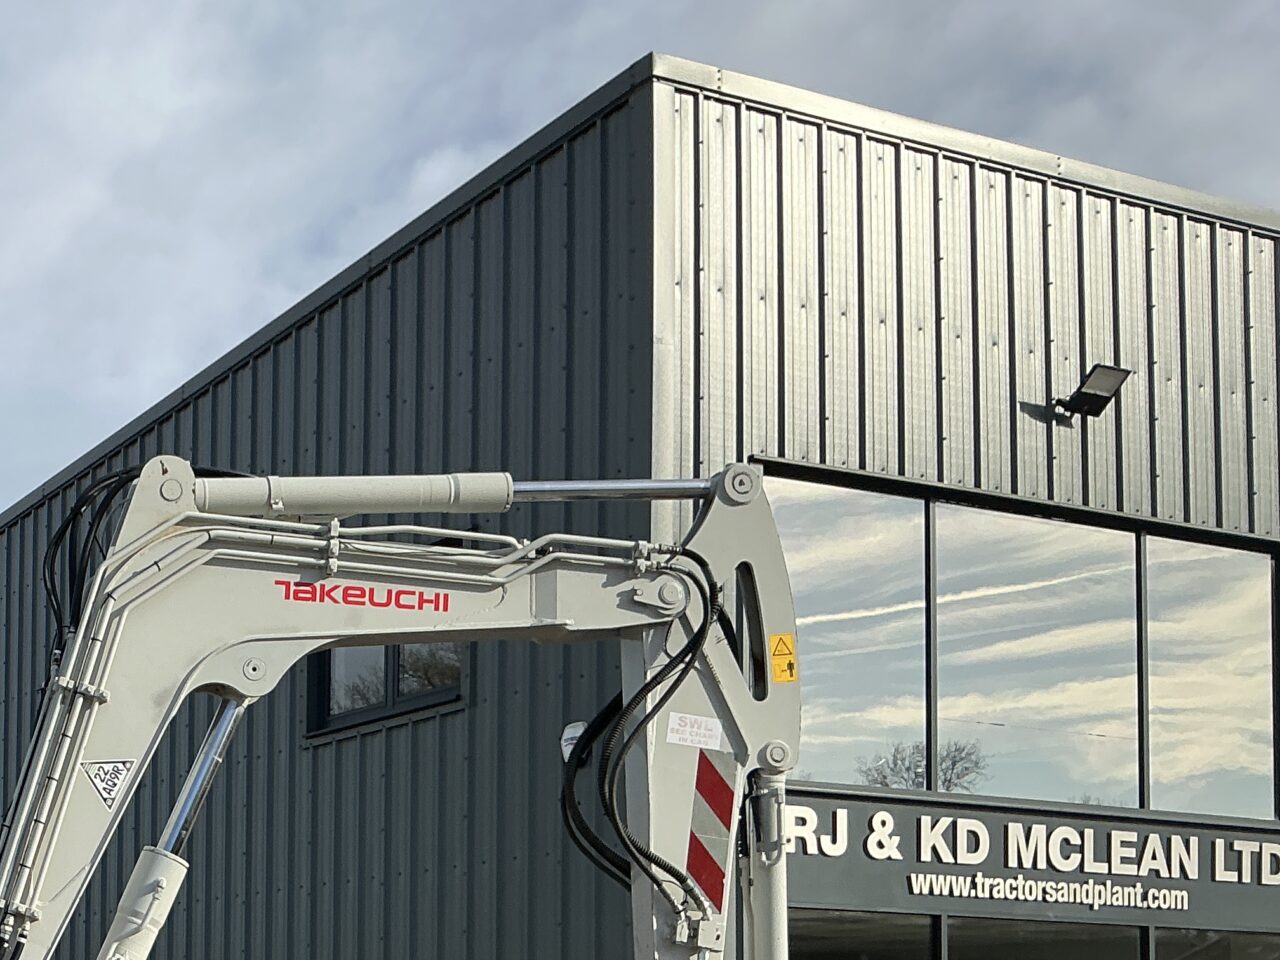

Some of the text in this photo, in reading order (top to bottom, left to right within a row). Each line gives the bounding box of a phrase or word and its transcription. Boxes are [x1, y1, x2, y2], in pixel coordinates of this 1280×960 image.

[677, 716, 713, 732] SWL
[94, 766, 110, 782] 22
[102, 765, 124, 796] AQ9R
[784, 804, 848, 857] RJ
[866, 810, 903, 860] &
[920, 815, 990, 866] KD
[1007, 822, 1200, 880] MCLEAN
[910, 870, 1189, 911] www.tractorsandplant.com
